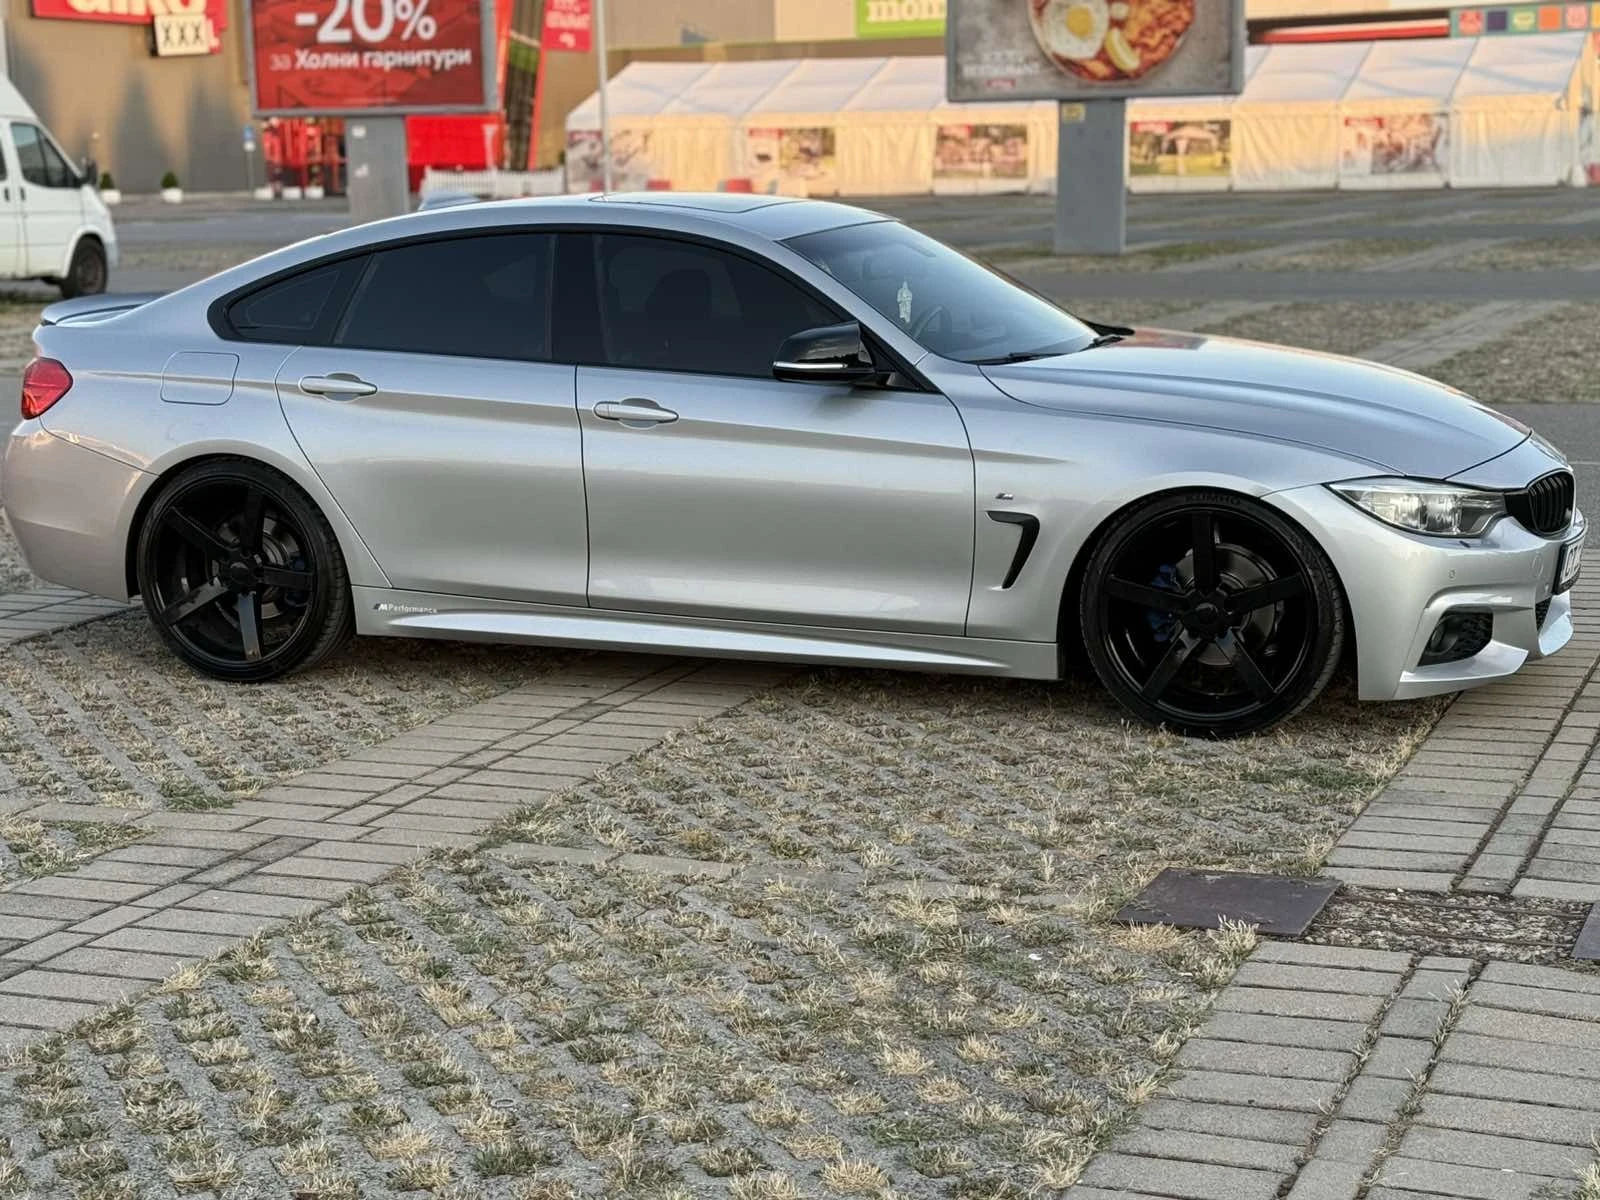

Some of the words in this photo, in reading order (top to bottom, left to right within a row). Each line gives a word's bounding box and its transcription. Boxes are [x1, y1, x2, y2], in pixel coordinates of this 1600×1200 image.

[295, 0, 437, 43] -20%
[295, 48, 359, 69] Холни
[363, 49, 472, 71] гарнитури
